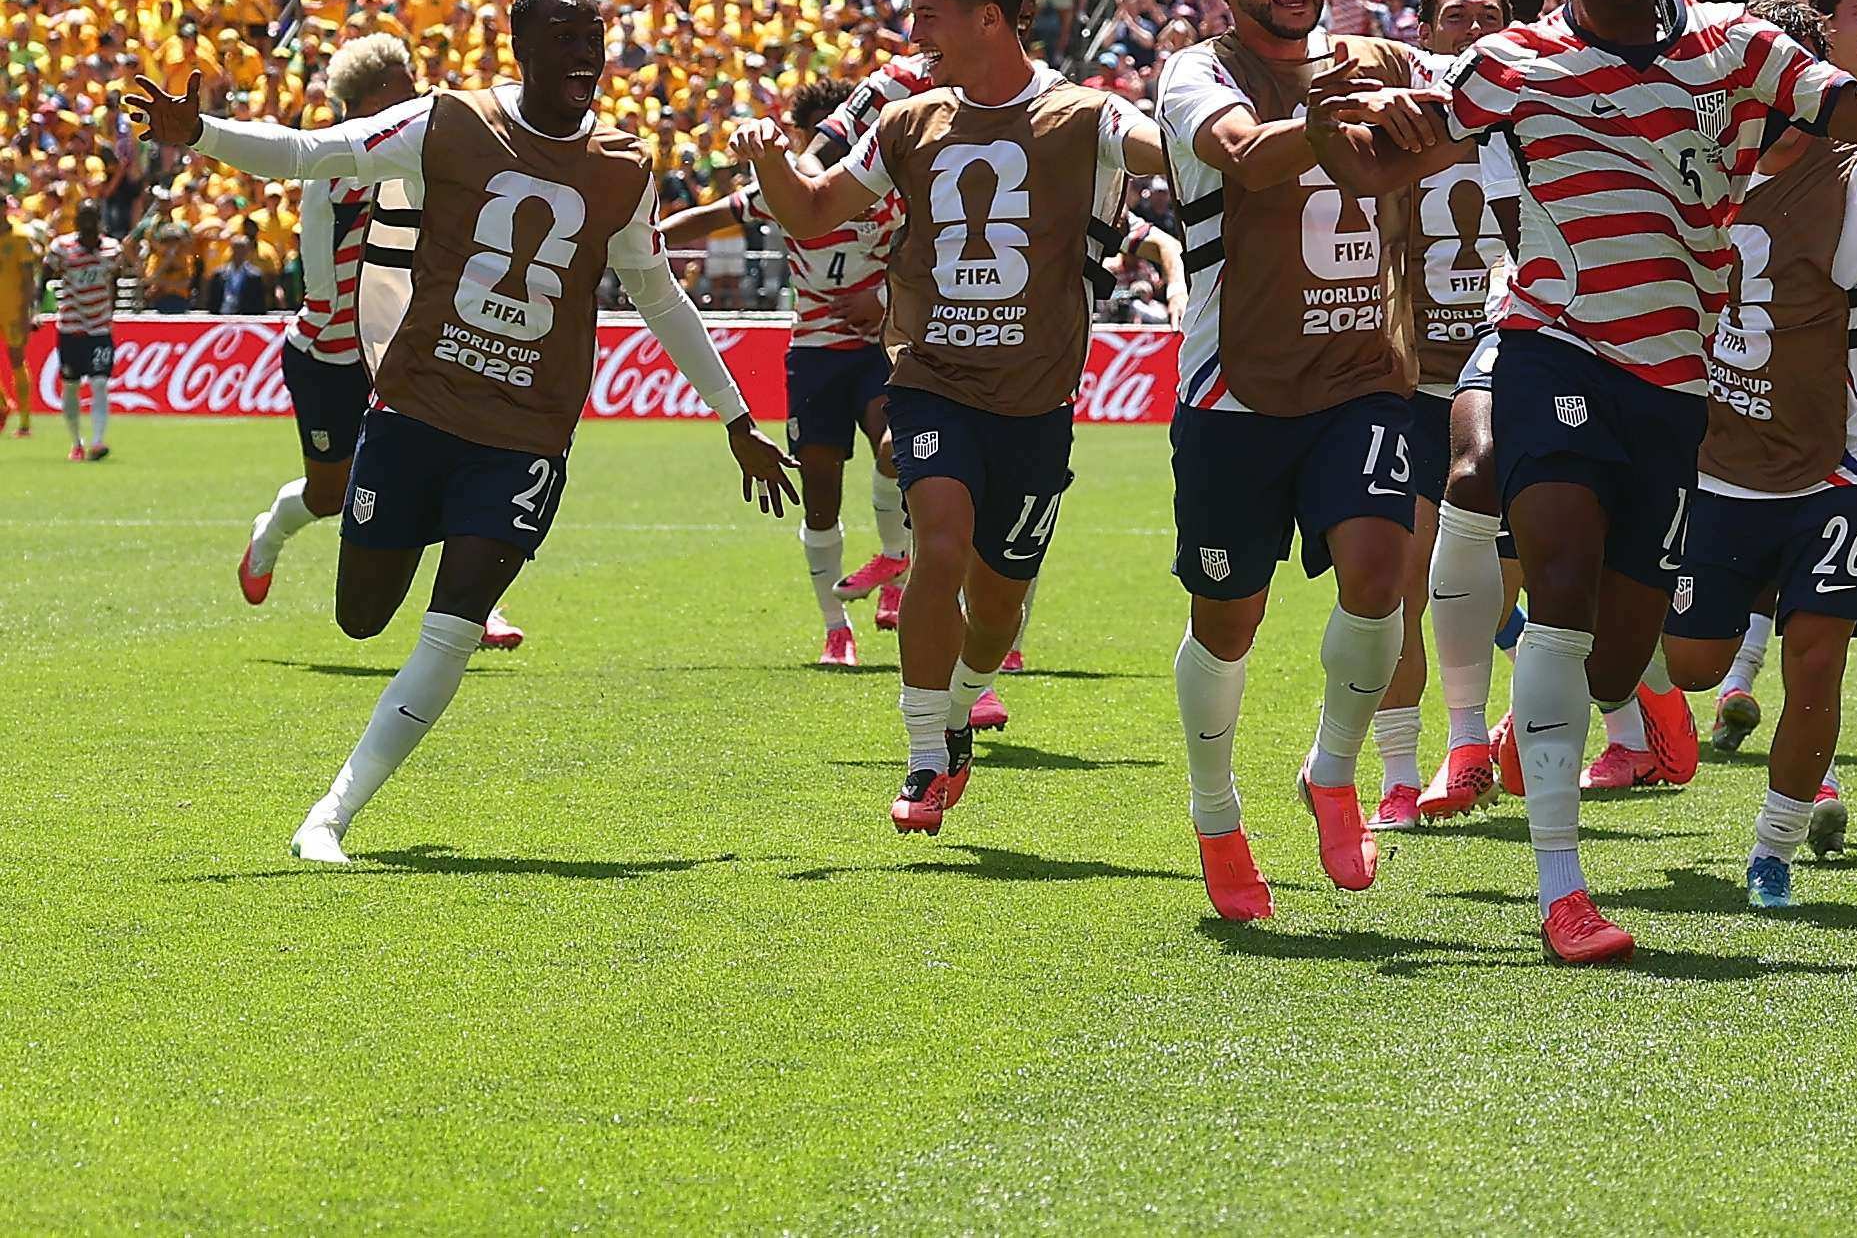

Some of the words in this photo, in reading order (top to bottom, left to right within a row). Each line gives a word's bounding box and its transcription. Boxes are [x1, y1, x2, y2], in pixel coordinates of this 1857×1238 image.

[1695, 92, 1725, 114] USA
[1334, 241, 1374, 262] FIFA
[827, 252, 846, 286] 4
[955, 268, 1001, 285] FIFA
[1303, 286, 1370, 306] WORLD
[481, 300, 526, 327] FIFA
[932, 305, 990, 321] WORLD
[993, 307, 1027, 321] CUP
[1425, 309, 1484, 320] WORLD
[442, 322, 504, 355] WORLD
[507, 345, 541, 364] CUP
[925, 322, 1025, 347] 2026
[1427, 322, 1474, 342] 20
[39, 323, 292, 412] Cca-Cola
[433, 339, 535, 388] 2026
[1709, 364, 1741, 387] ORLD
[1741, 377, 1772, 395] CUP
[1556, 397, 1584, 410] USA
[1708, 379, 1773, 420] 026
[915, 432, 937, 446] USA
[1362, 424, 1410, 483] 15
[356, 488, 374, 504] USA
[1005, 493, 1060, 546] 14
[1202, 548, 1226, 563] USA
